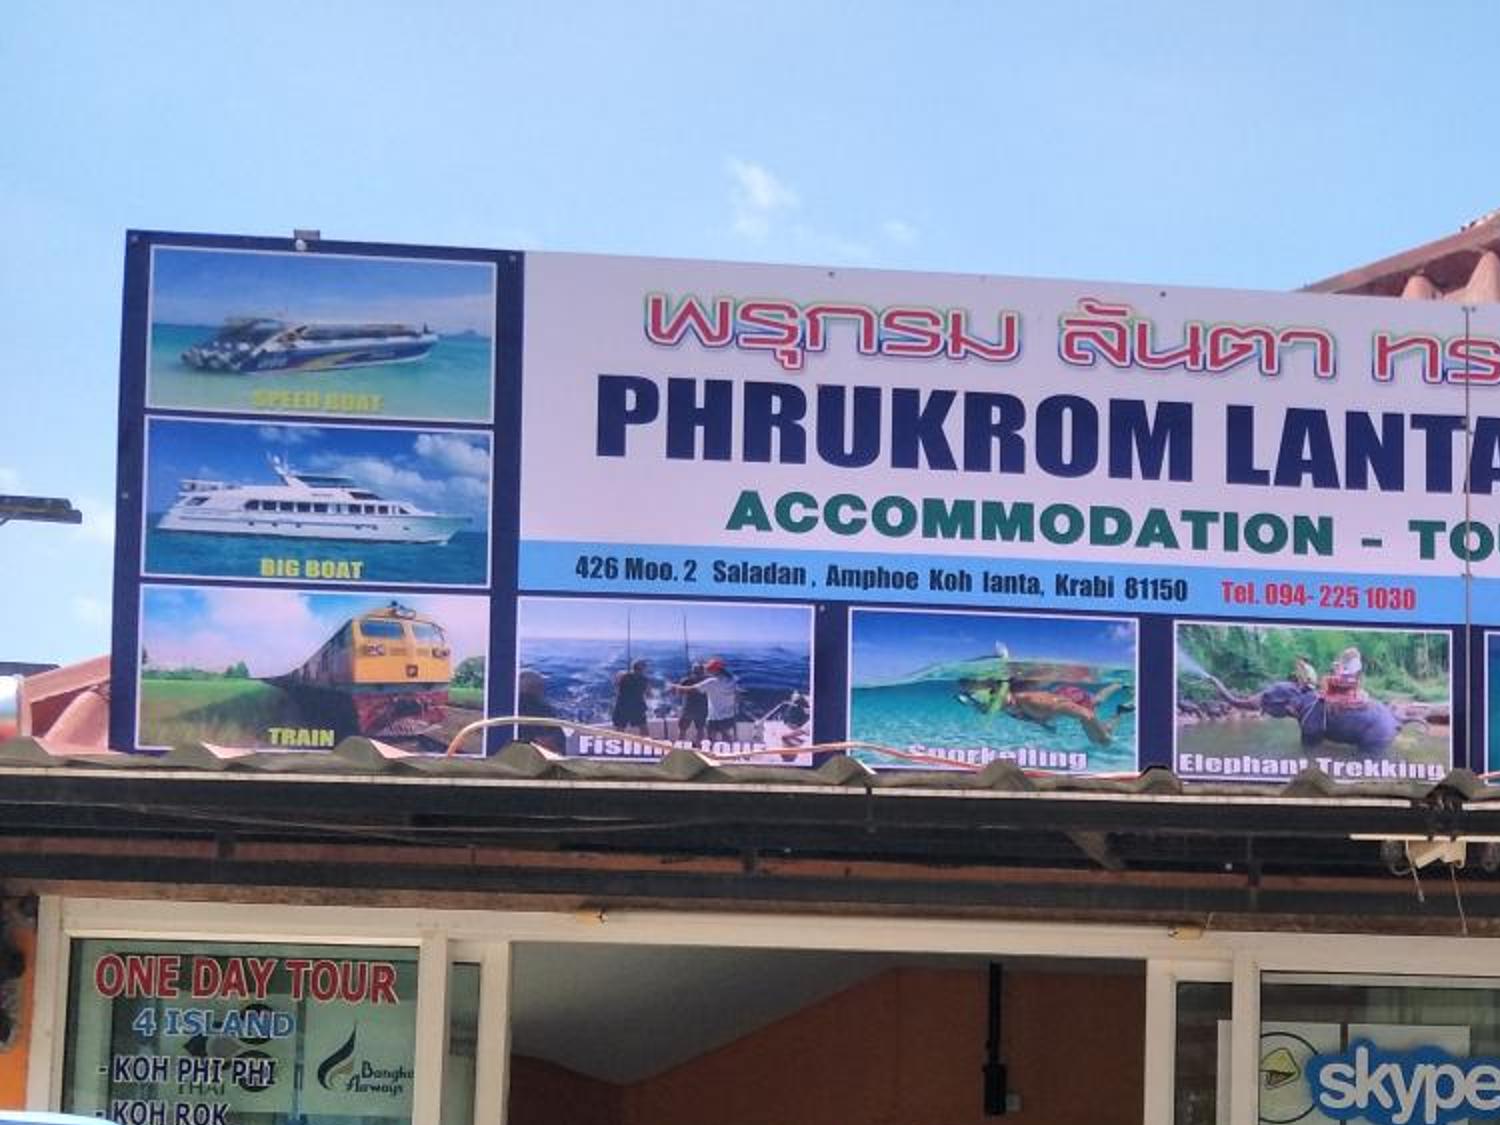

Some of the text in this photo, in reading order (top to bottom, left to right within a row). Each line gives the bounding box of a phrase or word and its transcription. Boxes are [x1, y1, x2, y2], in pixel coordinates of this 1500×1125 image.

[644, 293, 1022, 370] พรุกรม
[1059, 297, 1337, 378] ลันตา
[596, 374, 1193, 482] PHRUKROM
[725, 490, 1334, 557] ACCOMMODATION
[260, 558, 365, 579] BIG BOAT
[575, 555, 619, 580] 426
[625, 557, 678, 583] Moo.
[683, 558, 698, 583] 2
[826, 563, 919, 592] Amphoe
[929, 568, 972, 593] Koh
[1055, 574, 1115, 599] Krabi
[1125, 577, 1188, 603] 81150
[1221, 581, 1258, 605] Tel.
[1319, 585, 1359, 609] 225
[1366, 587, 1417, 611] 1030
[267, 727, 335, 747] TRAIN
[1315, 757, 1445, 781] Trekking
[95, 953, 399, 1004] ONE DAY TOUR
[132, 1008, 295, 1039] 4 ISLAND
[113, 1056, 276, 1087] KOH PHI PHI
[361, 1061, 415, 1083] Bangko
